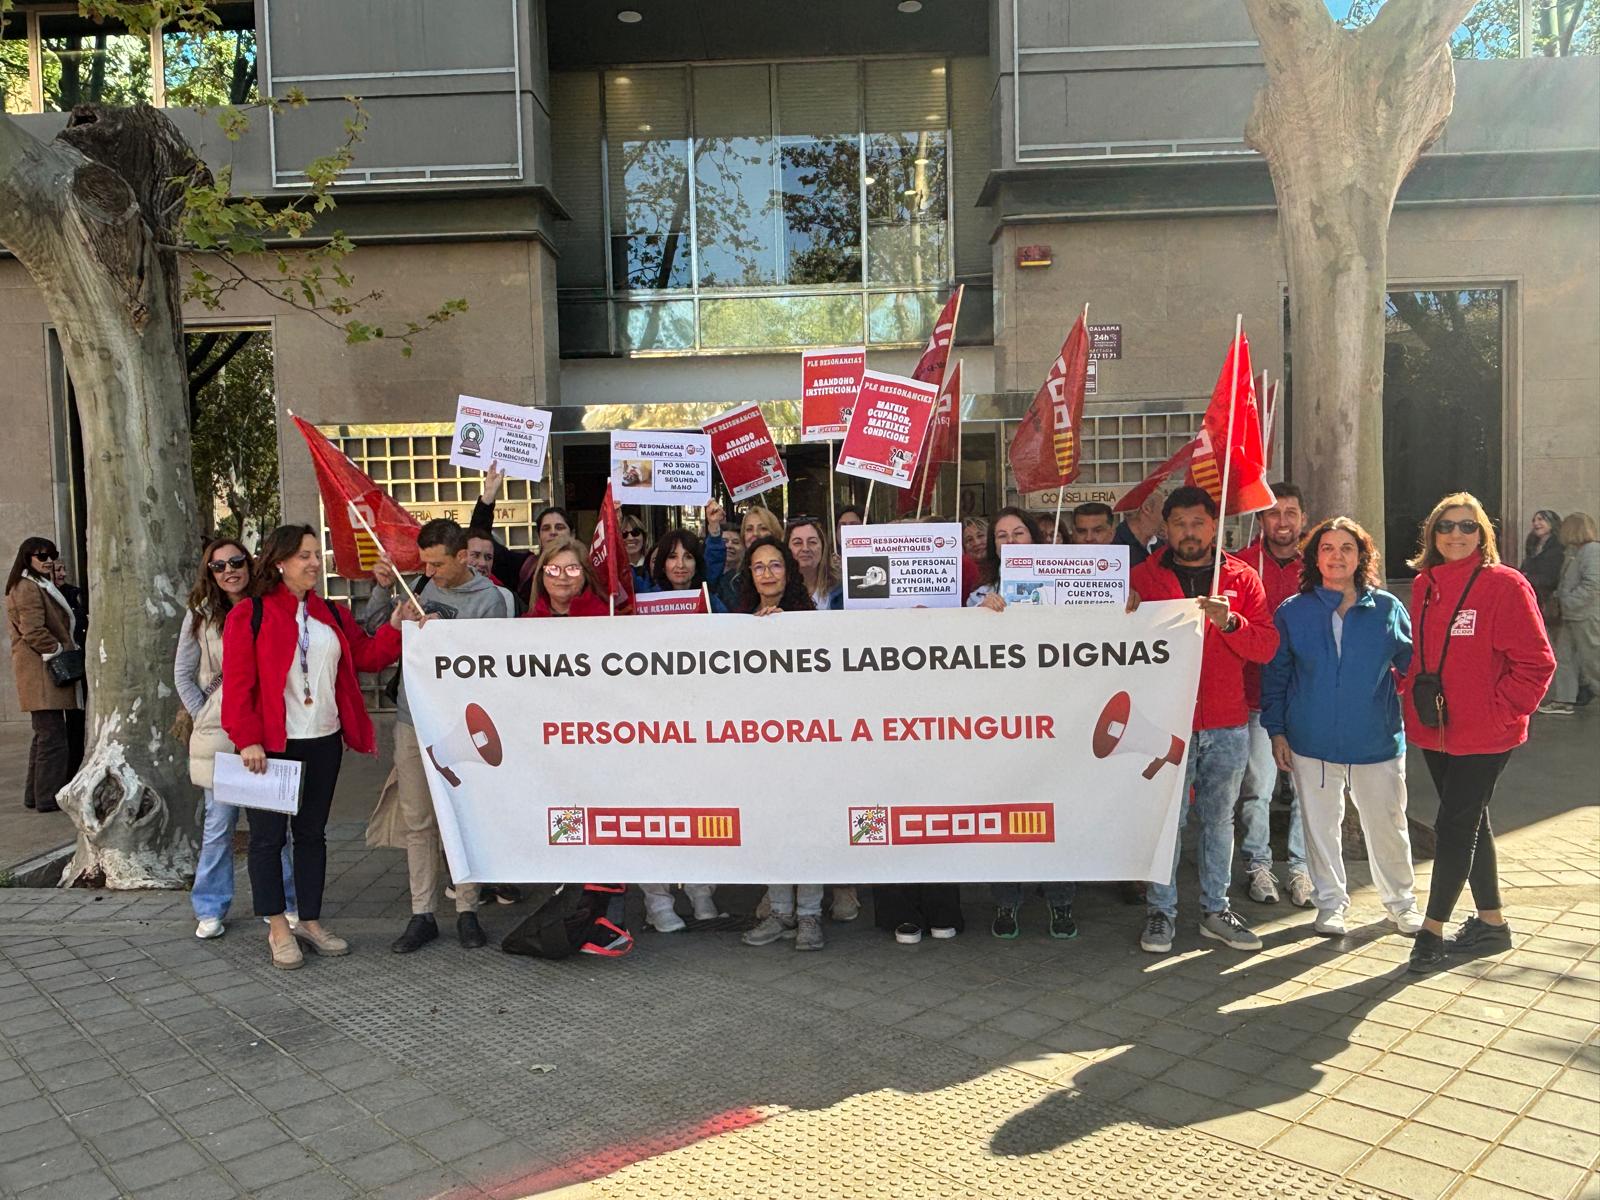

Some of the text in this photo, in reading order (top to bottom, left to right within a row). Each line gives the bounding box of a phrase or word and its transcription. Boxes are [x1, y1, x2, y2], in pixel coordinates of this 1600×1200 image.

[813, 377, 854, 387] ABANDONO
[876, 400, 908, 414] MATEIX
[868, 409, 912, 426] OCUPADOR,
[868, 418, 910, 434] MATEIXES
[506, 431, 533, 440] MISMAS
[863, 426, 910, 444] CONDICIONS
[504, 446, 530, 455] MISMAS
[718, 436, 770, 462] INSTITUCIONAL
[494, 451, 538, 464] CONDICIONES
[444, 510, 458, 520] DE
[912, 558, 956, 566] PERSONAL
[892, 577, 934, 585] EXTINGIR,
[434, 640, 1170, 679] POR UNAS CONDICIONES LABORALES DIGNAS
[542, 715, 1056, 745] PERSONAL LABORAL A EXTINGUIR
[595, 816, 691, 838] CCOO
[900, 812, 1002, 837] CCOO
